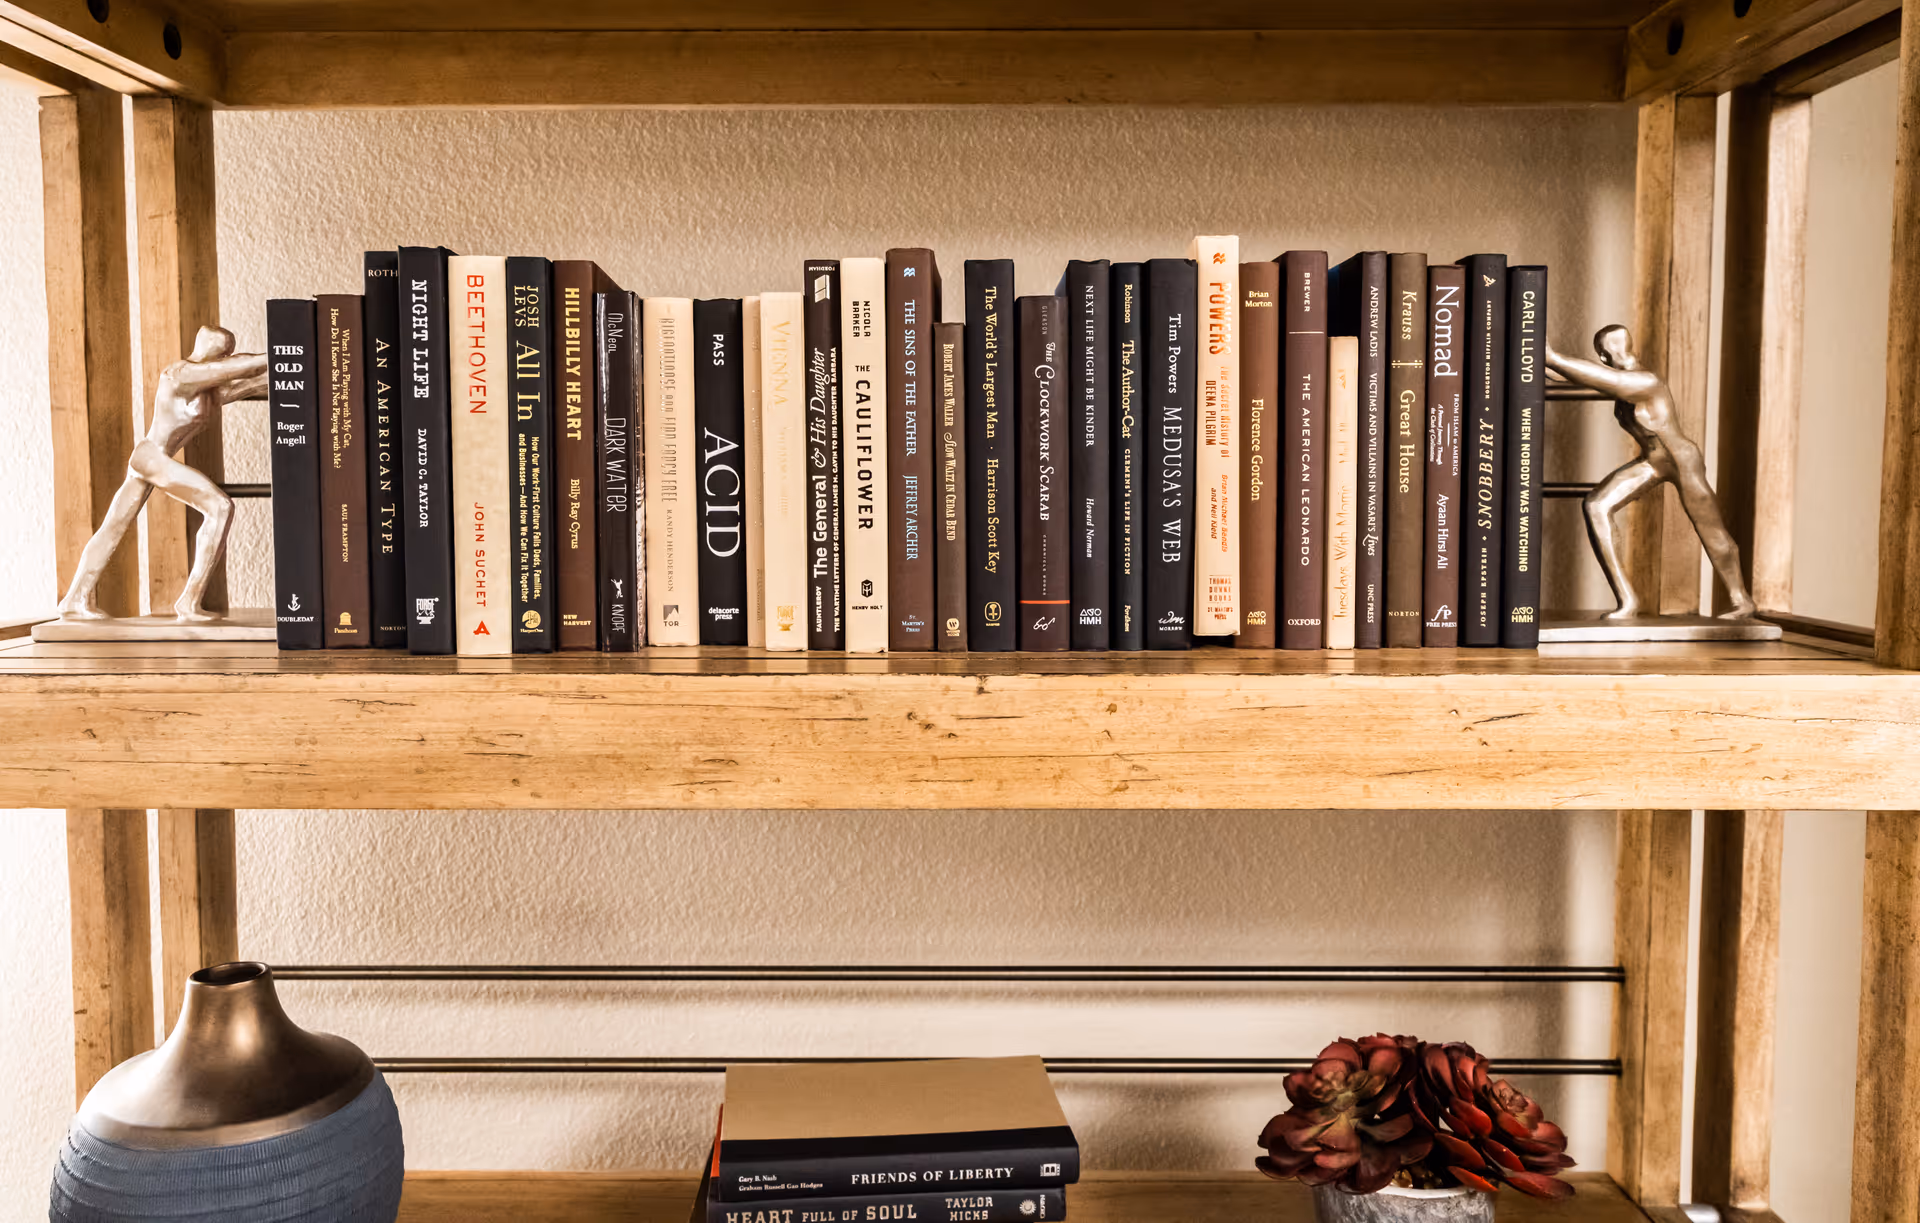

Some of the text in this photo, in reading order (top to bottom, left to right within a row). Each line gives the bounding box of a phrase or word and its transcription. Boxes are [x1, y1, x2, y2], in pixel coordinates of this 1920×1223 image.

[368, 269, 398, 277] ROTH
[1303, 272, 1311, 312] BREWER
[514, 285, 530, 328] LEVS
[526, 285, 540, 328] JOSH
[852, 300, 861, 338] BARKER
[863, 300, 871, 337] NICOLA
[1124, 283, 1133, 324] Robinson
[1369, 285, 1379, 358] ANDREW LADIS
[1401, 290, 1417, 340] Krauss
[1434, 284, 1460, 378] Nomad
[274, 345, 303, 355] THIS
[341, 328, 350, 352] When
[342, 358, 351, 373] Am
[411, 279, 430, 398] NIGHT LIFE
[466, 274, 487, 414] BEETHOVEN
[564, 287, 582, 441] HILLBILLY HEART
[712, 334, 725, 366] PASS
[982, 286, 999, 439] The World's Largest Man
[1045, 341, 1056, 362] THE
[1085, 285, 1095, 447] NEXT LIFE MIGHT BE KINDER
[1168, 313, 1182, 394] Tim Powers
[1520, 290, 1536, 383] CARLI LLOYD
[275, 363, 303, 373] OLD
[275, 380, 304, 390] MAN
[340, 373, 351, 401] Playing
[516, 340, 541, 422] All In
[904, 299, 917, 457] THE SINS OF THE FATHER
[943, 343, 956, 427] ROBERT JAMES WALLER
[1121, 339, 1135, 439] The Author-Cat
[277, 422, 305, 432] Roger
[341, 418, 352, 432] My
[343, 401, 351, 418] with
[605, 417, 627, 458] DARK
[1205, 380, 1217, 446] DEENA PILGRIM
[277, 436, 306, 445] Angell
[375, 338, 396, 554] AN AMERICAN TYPE
[809, 347, 829, 579] The General & His Daughter
[855, 379, 874, 530] CAULIFLOWER
[1034, 364, 1056, 521] CLOCKWORK SCARAB
[1251, 398, 1265, 501] Florence Gordon
[1300, 373, 1311, 566] THE AMERICAN LEONARDO
[1367, 372, 1378, 532] VICTIMS AND VILLAINS IN VASARI'S
[1399, 389, 1416, 493] Great House
[417, 428, 429, 528] DAVID C. TAYLOR
[703, 426, 741, 558] ACID
[943, 432, 958, 541] SLOW WALTZ IN CEDAR BEND
[1124, 448, 1132, 498] CLEMENS'S
[1162, 406, 1182, 563] MEDUSA'S WEB
[1477, 418, 1494, 530] SNOBBERY
[1518, 407, 1532, 572] WHEN NOBODY WAS WATCHING
[568, 478, 581, 549] Billy Ray Cyrus
[902, 474, 919, 561] JEFFREY ARCHER
[984, 458, 1000, 574] Harrison Scott Key
[1086, 498, 1095, 558] Howard Norman
[1124, 524, 1131, 534] IN
[1363, 531, 1378, 556] Lives
[1436, 493, 1450, 569] Ayaan Hirsi Ali
[474, 501, 487, 607] JOHN SUCHET
[666, 540, 674, 592] HENDERSON
[1480, 547, 1488, 587] EPSTEIN
[611, 603, 626, 634] KNOPF
[1367, 583, 1375, 624] UNC PRESS
[1511, 615, 1533, 623] HMH
[851, 1167, 1014, 1185] FRIENDS OF LIBERTY
[945, 1197, 993, 1208] TAYLOR
[727, 1204, 917, 1223] HEART FULL OF SOUL
[950, 1209, 988, 1221] HICKS
